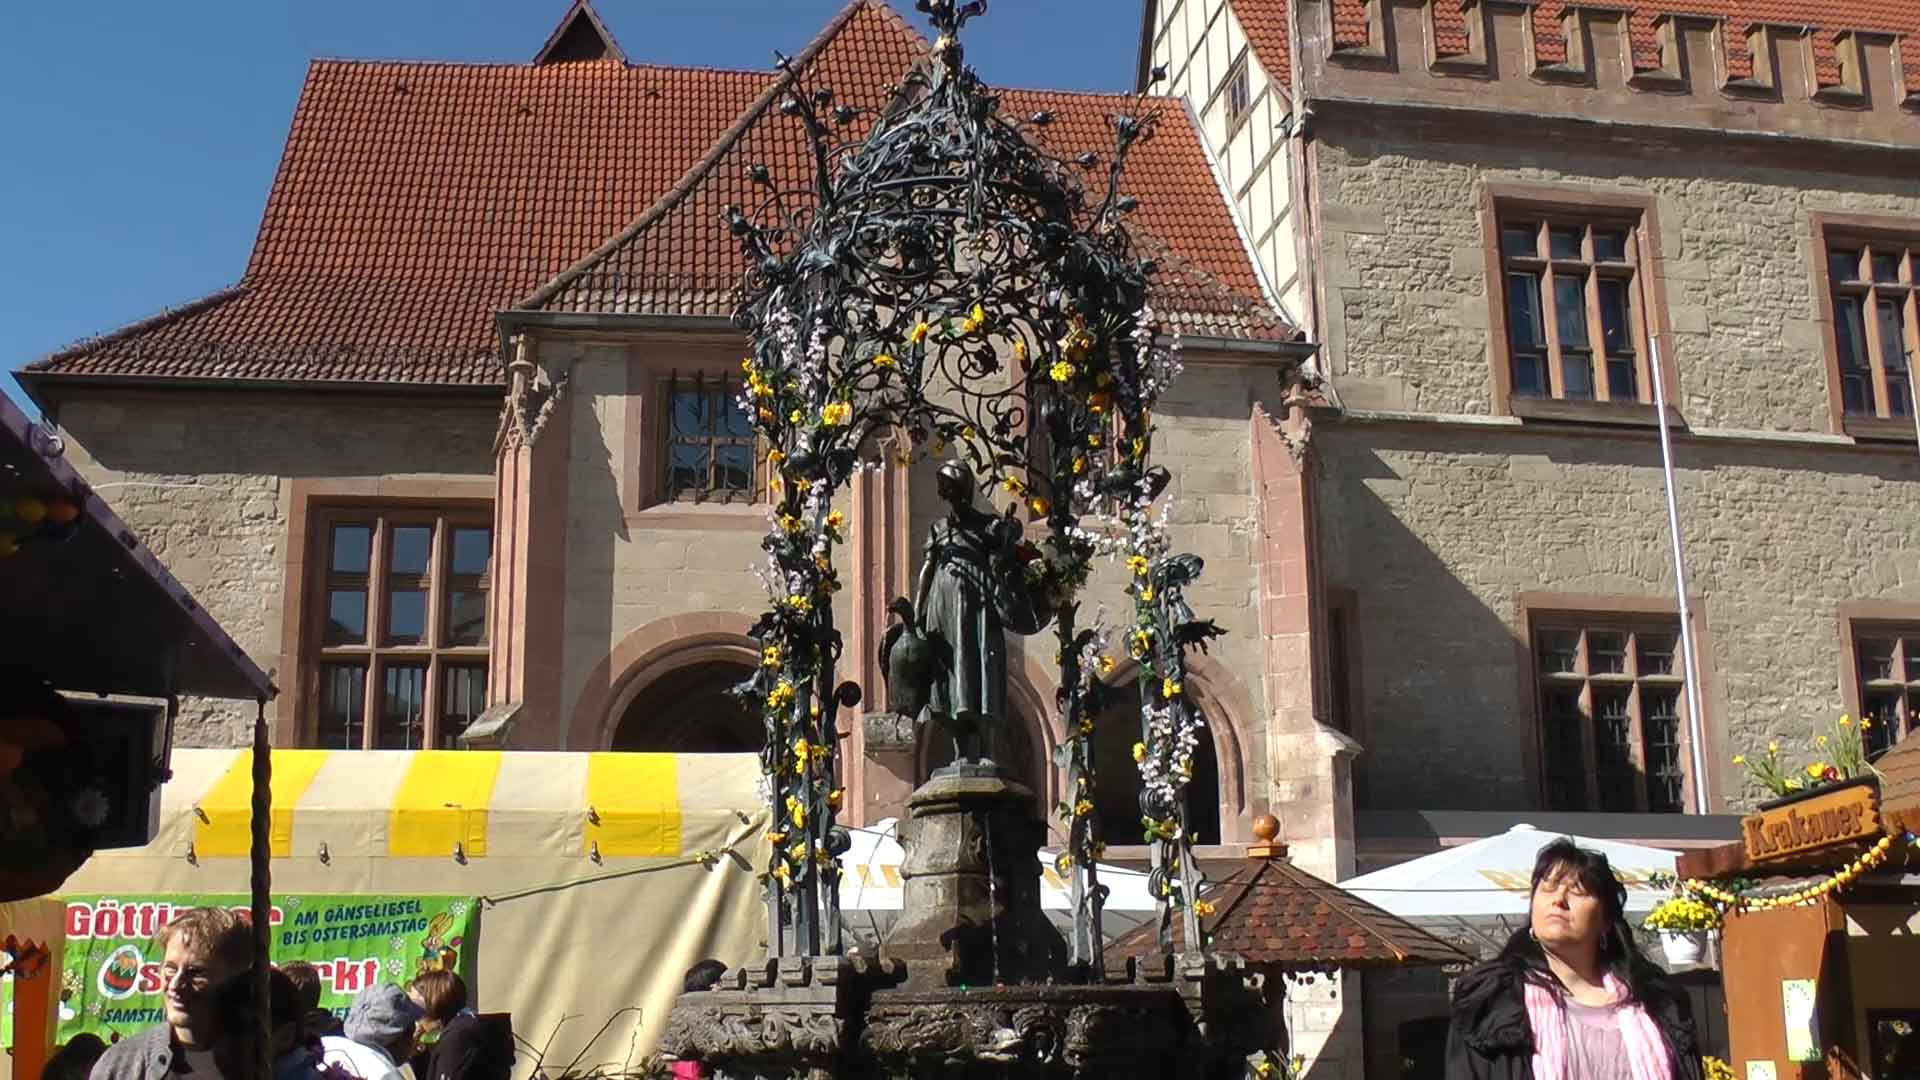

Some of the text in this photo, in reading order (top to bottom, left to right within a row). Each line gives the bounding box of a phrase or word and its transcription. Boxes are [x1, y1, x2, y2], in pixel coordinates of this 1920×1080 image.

[1746, 800, 1864, 856] Krakauer
[294, 899, 423, 926] AM GÄNSELIESEL
[282, 917, 428, 946] BIS OSTERSAMSTAG
[103, 1007, 167, 1023] SAMSTA
